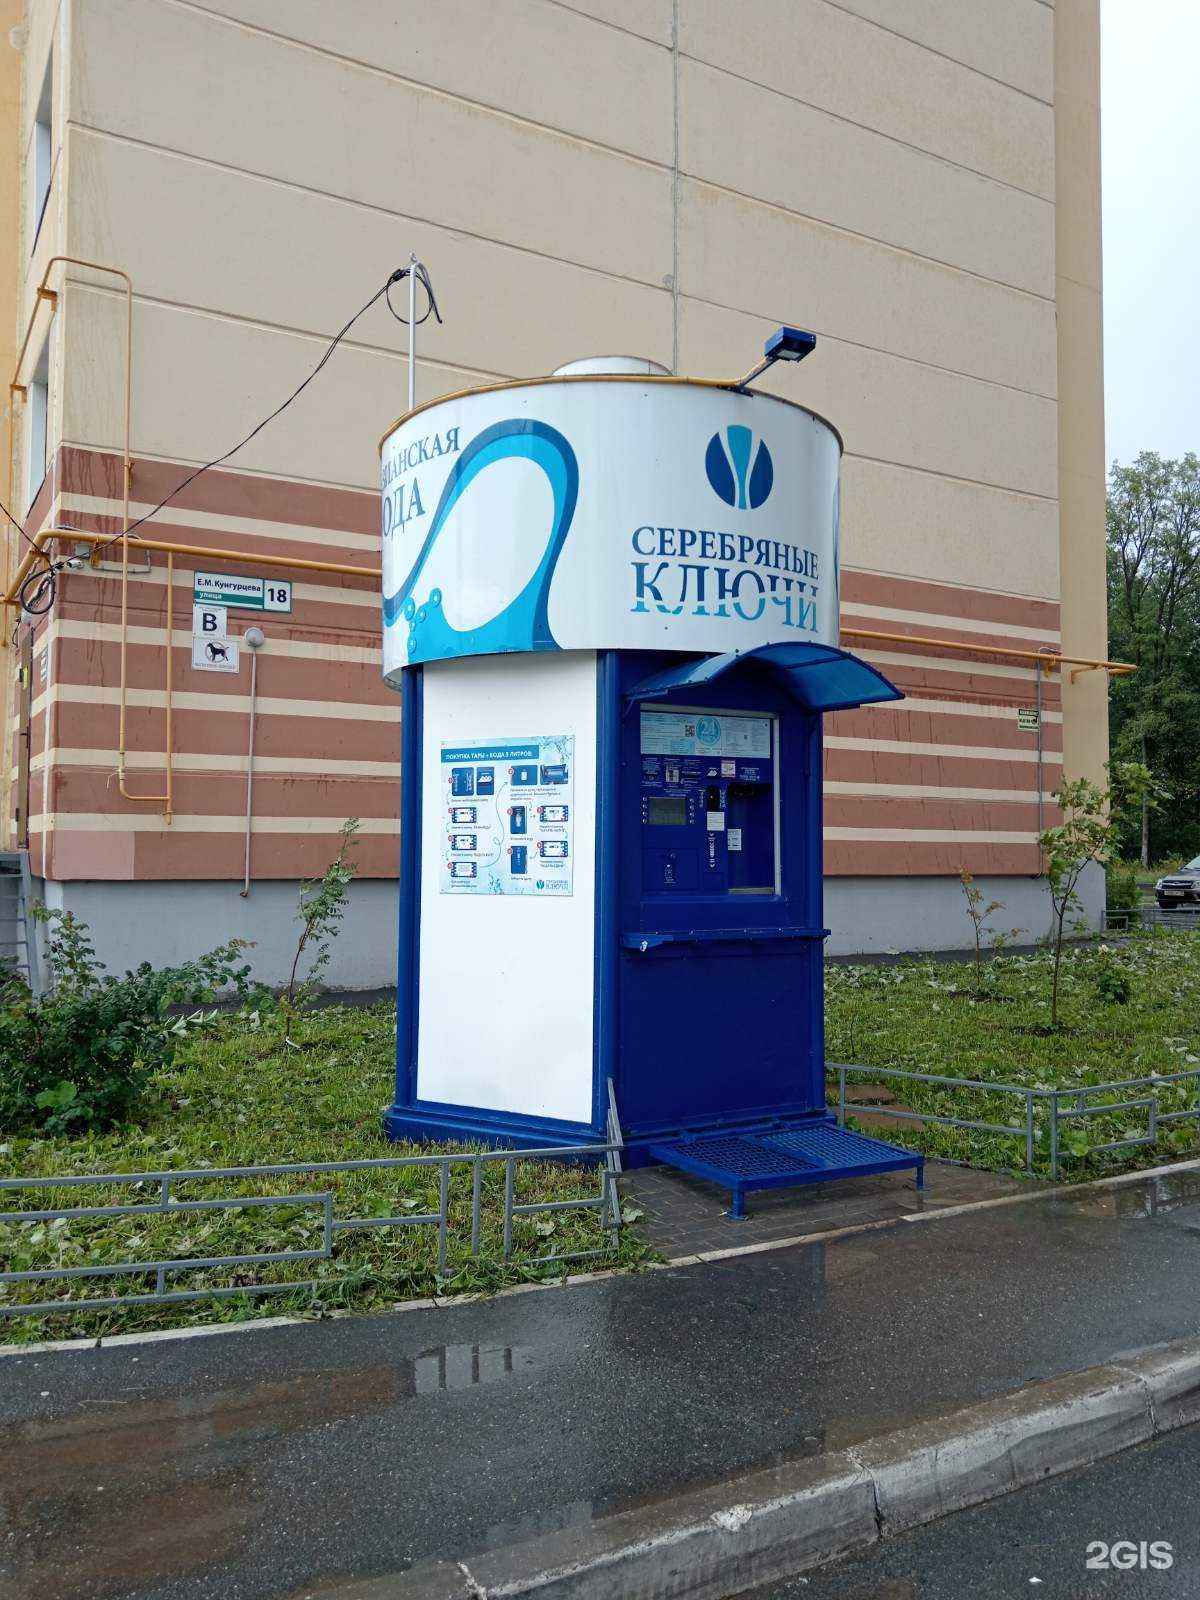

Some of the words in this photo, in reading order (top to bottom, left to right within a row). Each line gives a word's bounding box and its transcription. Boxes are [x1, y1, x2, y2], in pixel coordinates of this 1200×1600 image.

[382, 476, 426, 541] ОДА
[631, 526, 819, 581] СЕРЕБРЯНЫЕ
[214, 581, 261, 592] Кунгурцева
[267, 588, 288, 603] 18
[199, 592, 222, 600] улица
[630, 561, 819, 633] КЛЮЧИ
[202, 613, 217, 631] В
